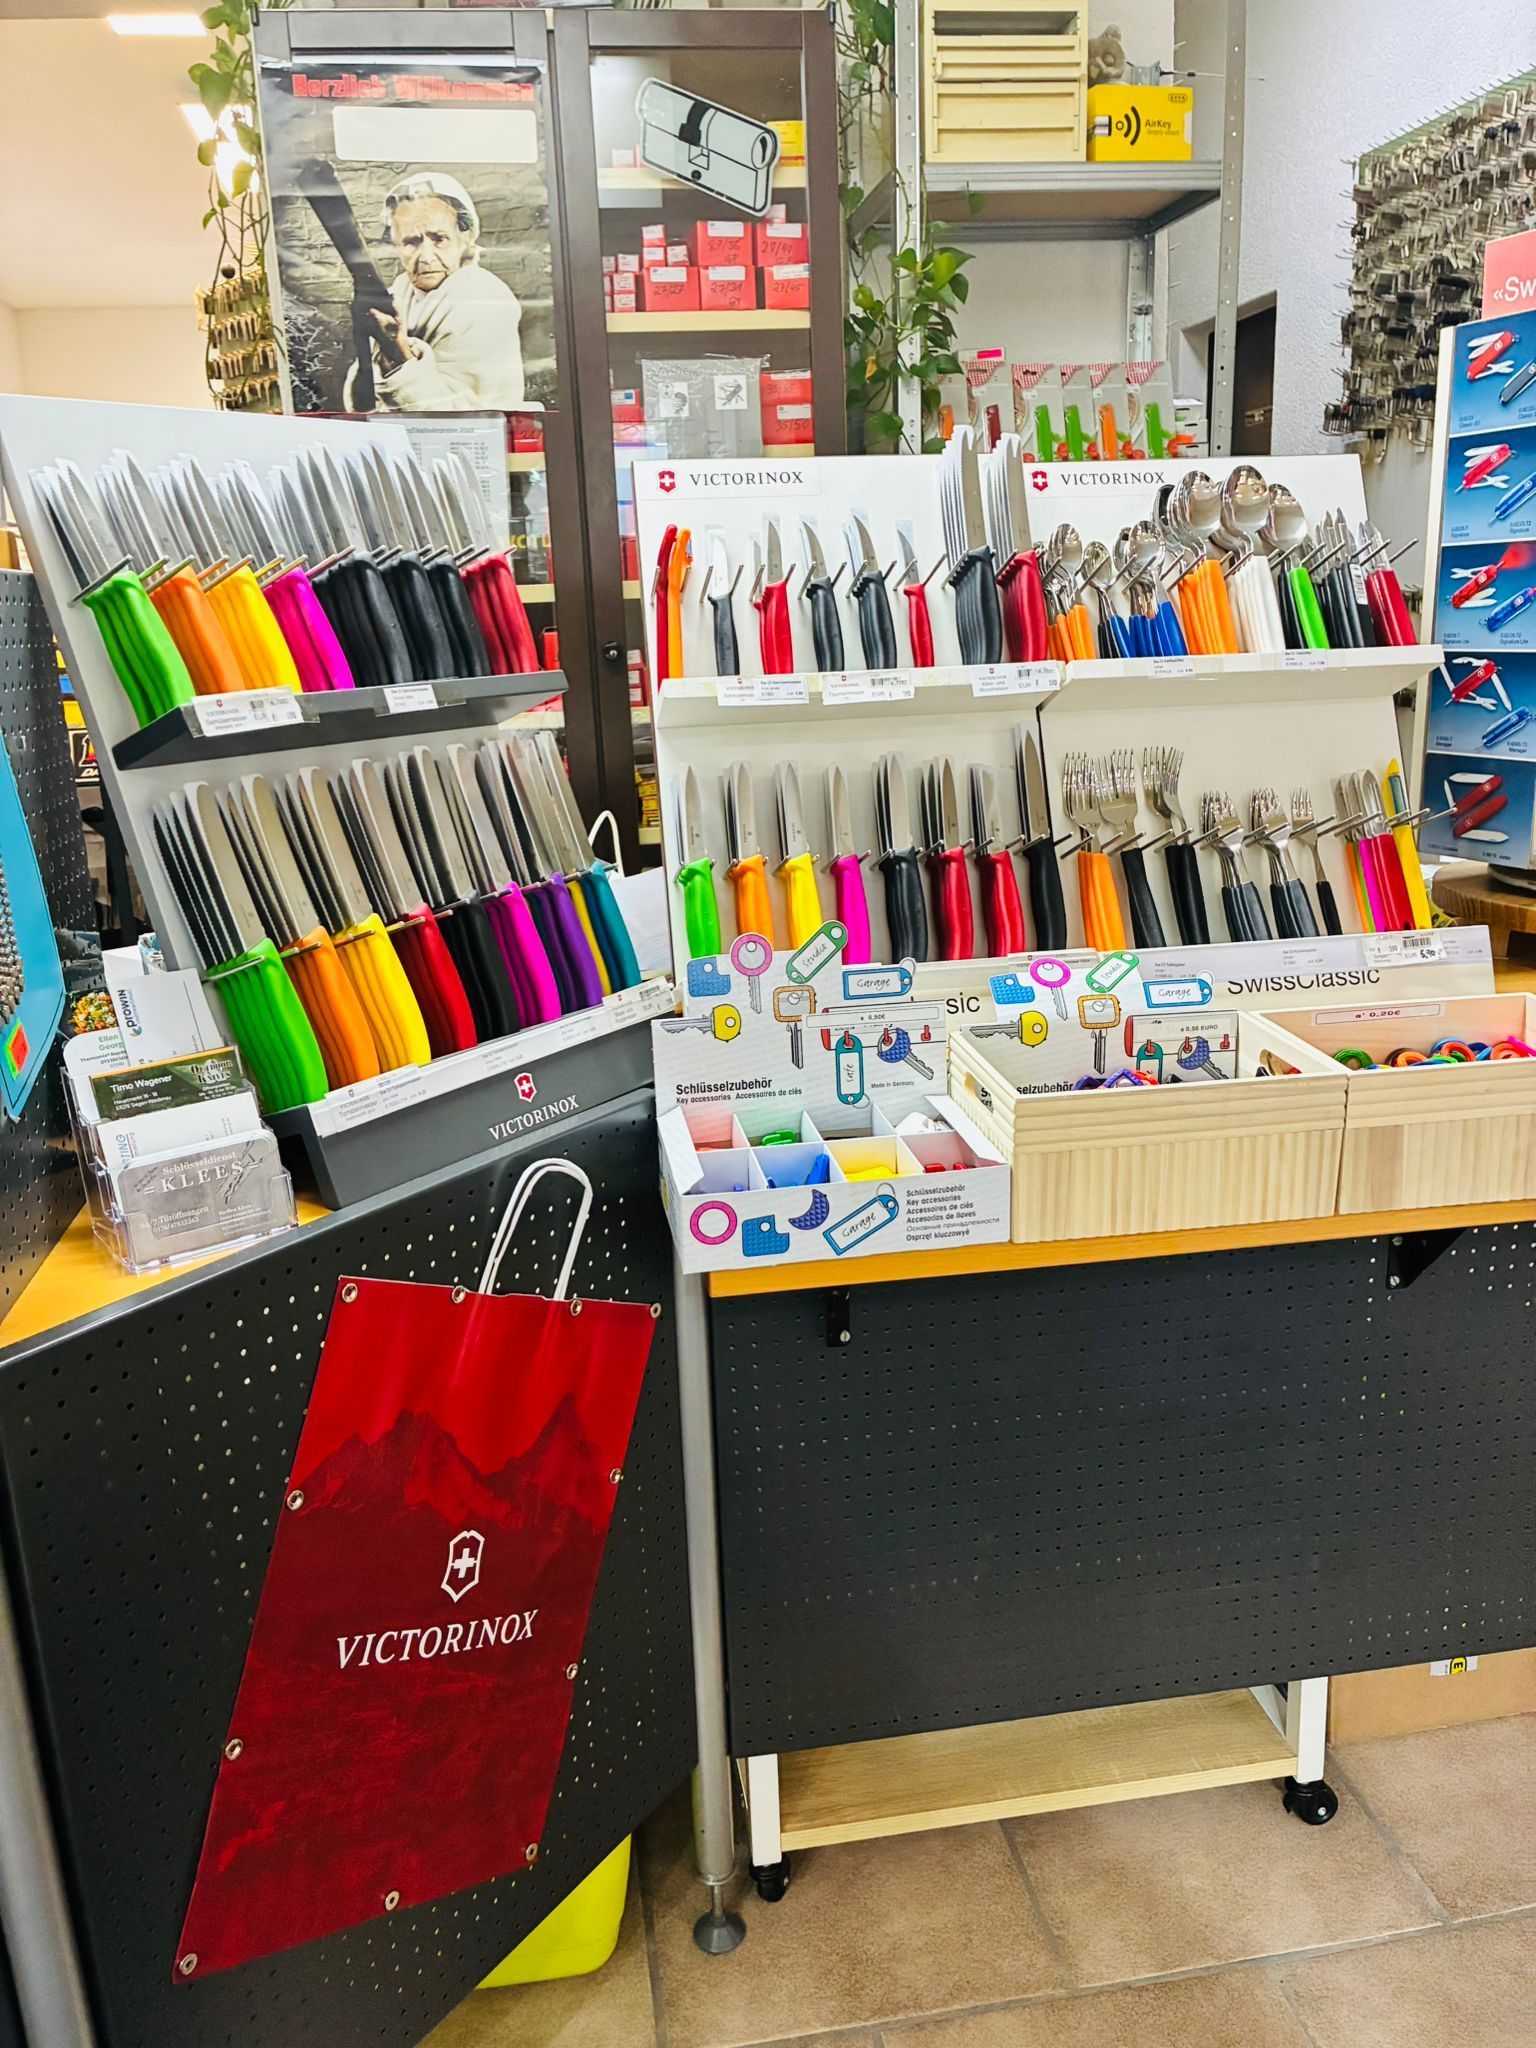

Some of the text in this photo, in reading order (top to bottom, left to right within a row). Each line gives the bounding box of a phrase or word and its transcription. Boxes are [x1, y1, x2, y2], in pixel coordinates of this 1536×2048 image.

[292, 73, 535, 102] Herzlich Willkommen
[1145, 120, 1172, 129] AirKey
[690, 471, 804, 486] VICTORINOX
[1060, 471, 1165, 486] VICTORINOX
[856, 977, 891, 990] Garage
[1158, 987, 1191, 1000] Garage
[98, 1033, 119, 1042] Ellen
[110, 1075, 172, 1093] Timo Wagener
[676, 1077, 773, 1095] Schlüsselzubehör
[676, 1097, 689, 1105] Key
[691, 1094, 731, 1103] accessories
[735, 1089, 777, 1100] Accessoires
[487, 1094, 580, 1141] VICTORINOX
[162, 1152, 236, 1175] Schlüsseldienst
[906, 1184, 966, 1197] Schlüsselzubehör
[921, 1194, 962, 1205] accessories
[157, 1206, 209, 1224] Türöffnungen
[906, 1205, 947, 1215] Accessoires
[949, 1203, 958, 1211] de
[842, 1211, 877, 1238] Garage
[906, 1210, 977, 1224] Accesorios de llaves
[337, 1609, 539, 1670] VICTORINOX
